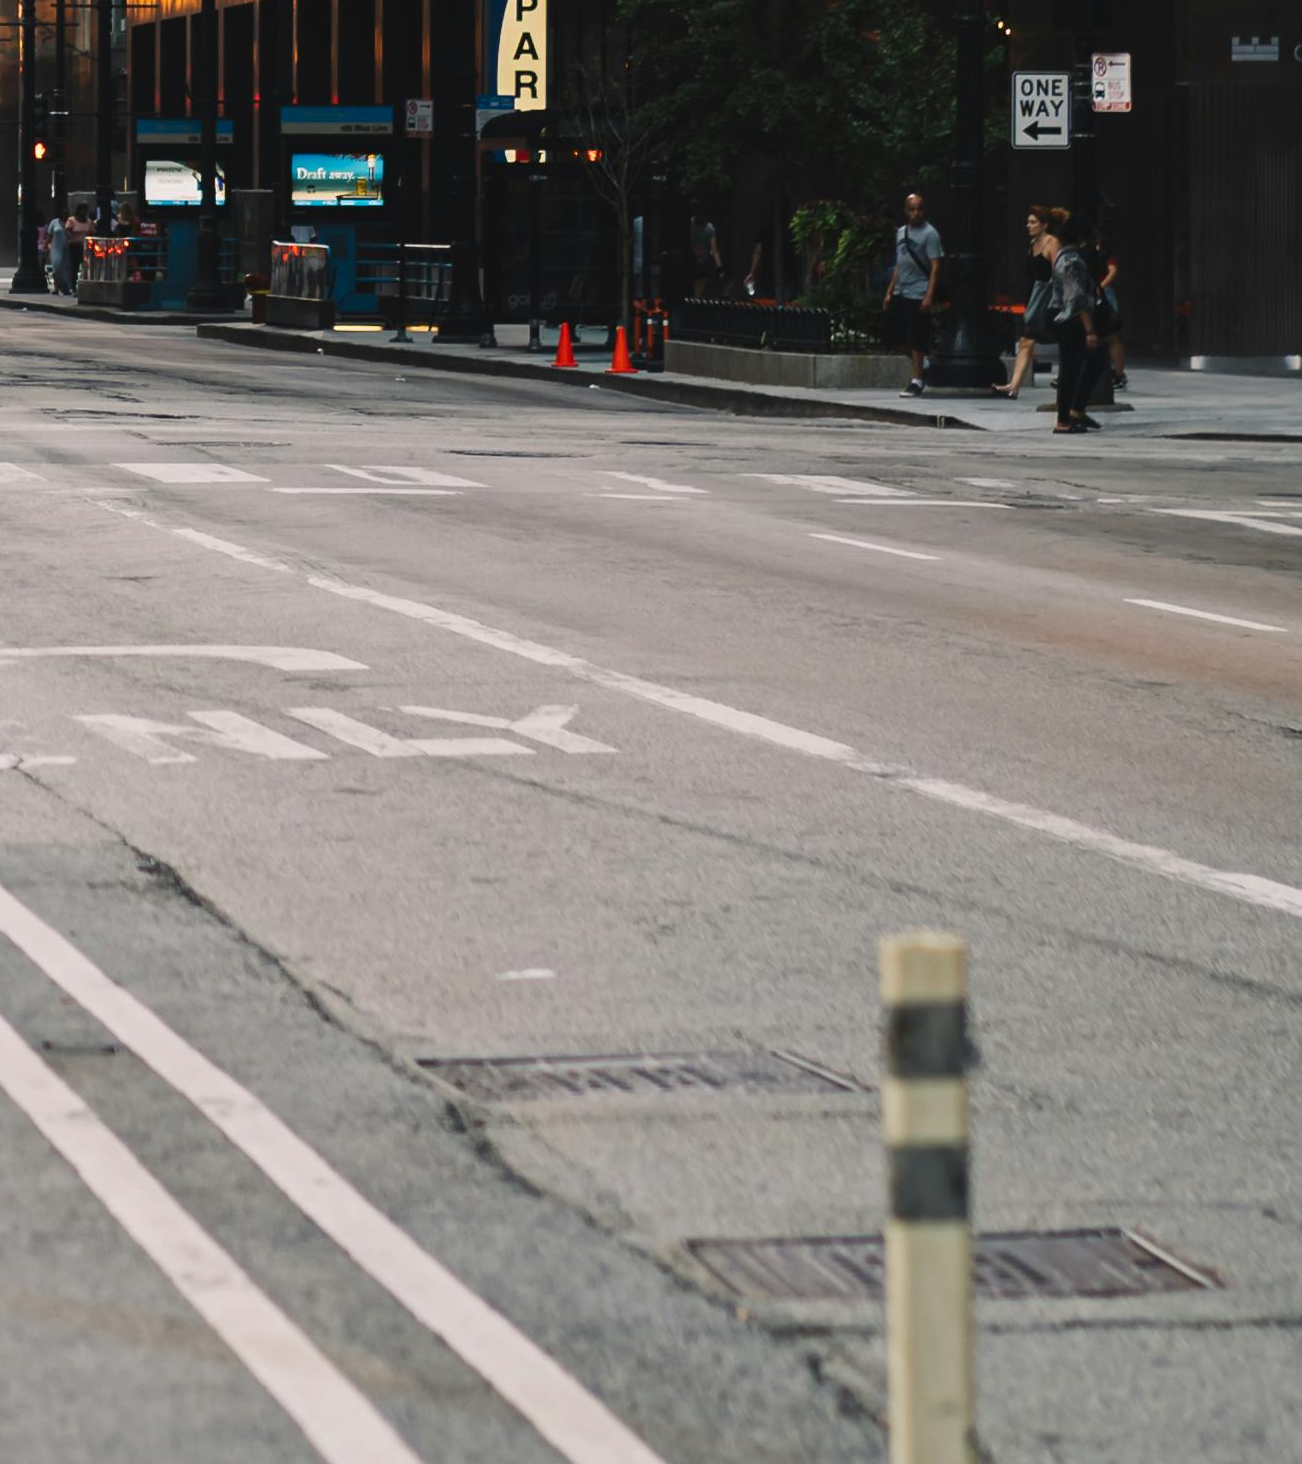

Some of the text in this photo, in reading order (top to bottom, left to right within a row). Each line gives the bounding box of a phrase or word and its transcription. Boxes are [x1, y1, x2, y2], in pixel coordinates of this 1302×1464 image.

[1021, 78, 1063, 96] ONE
[1020, 100, 1064, 117] WAY
[296, 166, 355, 182] Draft away.
